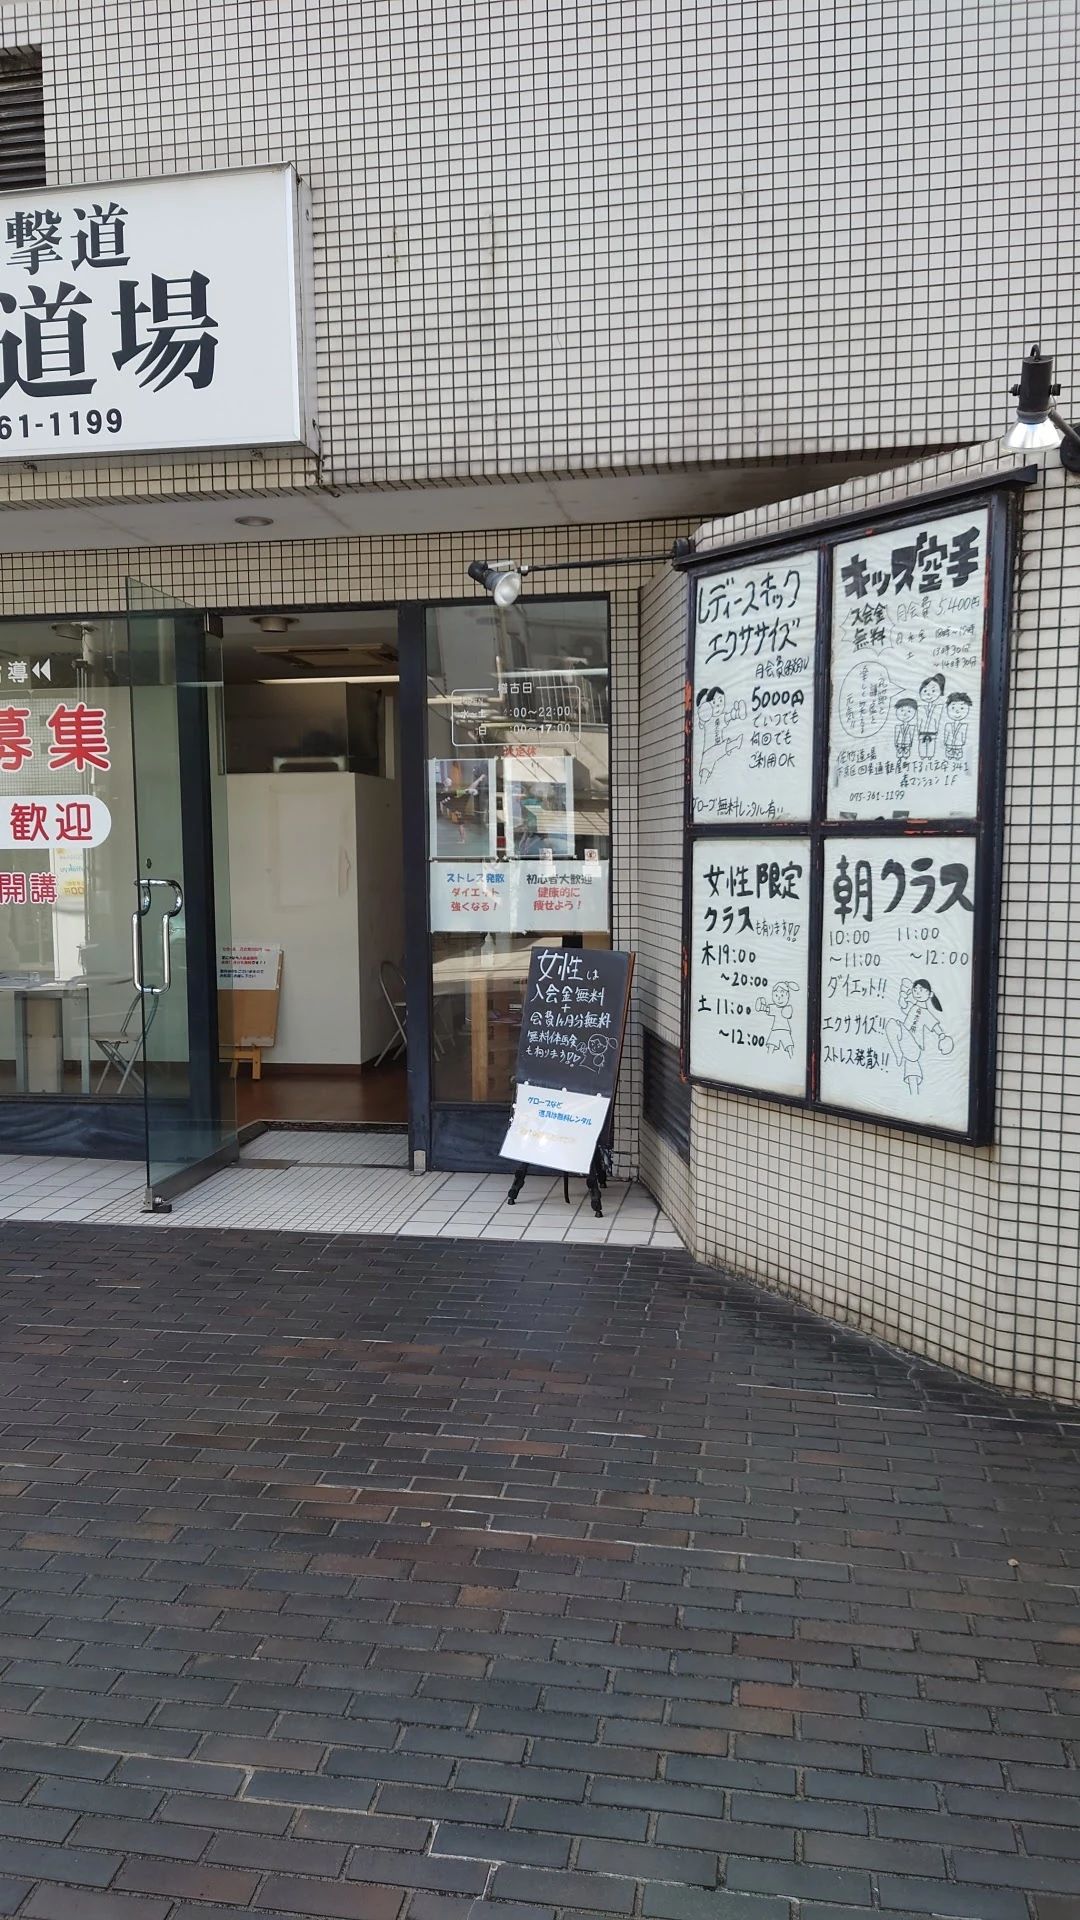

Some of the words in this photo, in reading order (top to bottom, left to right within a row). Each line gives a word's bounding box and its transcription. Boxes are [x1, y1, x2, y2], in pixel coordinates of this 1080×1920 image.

[0, 270, 218, 399] 道場
[0, 408, 122, 439] 61-1199
[841, 526, 981, 599] キッズ空手
[698, 570, 801, 624] レディースキック
[705, 617, 800, 664] エクササイズ
[751, 686, 804, 712] 5000円
[703, 861, 803, 900] 女性限定
[833, 855, 975, 925] 朝クラス
[829, 930, 870, 946] 10:00
[898, 927, 940, 942] 11:00
[530, 983, 605, 1007] 入会金無料
